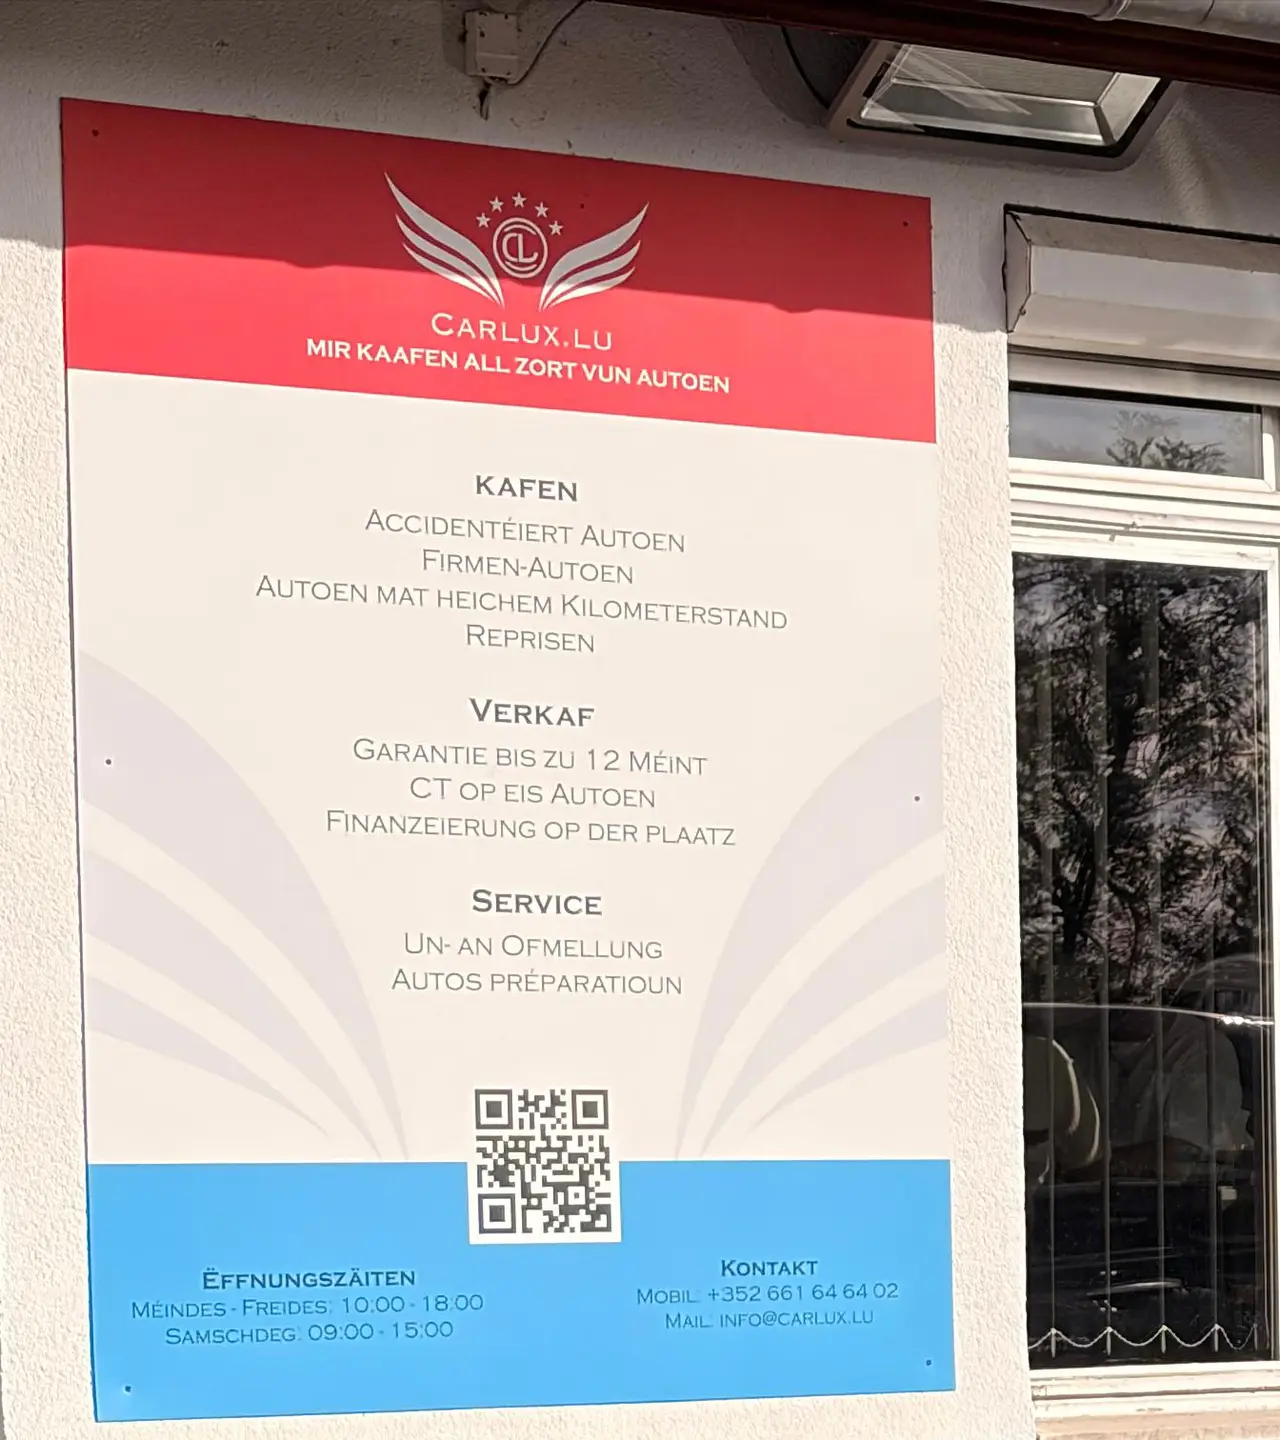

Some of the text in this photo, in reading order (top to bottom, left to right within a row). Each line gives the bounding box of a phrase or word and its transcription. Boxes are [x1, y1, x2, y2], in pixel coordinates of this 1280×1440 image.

[430, 311, 614, 353] CARLUX.LU
[306, 338, 730, 394] MIR KAAFEN ALL ZORT VUN AUTOEN
[475, 474, 578, 502] KAFEN
[365, 508, 685, 553] ACCIDENTÉIERT AUTOEN
[422, 548, 633, 585] FIRMEN-AUTOEN
[255, 574, 788, 630] AUTOEN MAT HEICHEM KILOMETERSTAND
[466, 623, 595, 653] REPRISEN
[468, 697, 595, 727] VERKAF
[353, 737, 709, 776] GARANTIE BIS ZU 12 MÉINT
[409, 776, 655, 808] CT OP EIS AUTOEN
[327, 809, 736, 846] FINANZEIERUNG OP DER PLAATZ
[472, 888, 603, 916] SERVICE
[404, 932, 663, 960] UN- AN OFMELLUNG
[391, 967, 682, 995] AUTOS PRÉPARATIOUN
[202, 1267, 415, 1290] ËFFNUNGSZÄITEN
[721, 1259, 819, 1277] KONTAKT
[131, 1299, 227, 1319] MÉINDES
[342, 1295, 406, 1314] 10:00
[422, 1293, 484, 1312] 18:00
[707, 1285, 762, 1303] +352
[766, 1284, 803, 1302] 661
[811, 1283, 838, 1301] 64
[842, 1283, 868, 1300] 64
[872, 1282, 899, 1299] 02
[307, 1322, 374, 1342] 09:00
[392, 1320, 454, 1339] 15:00
[719, 1309, 874, 1328] INFO@CARLUX.LU
